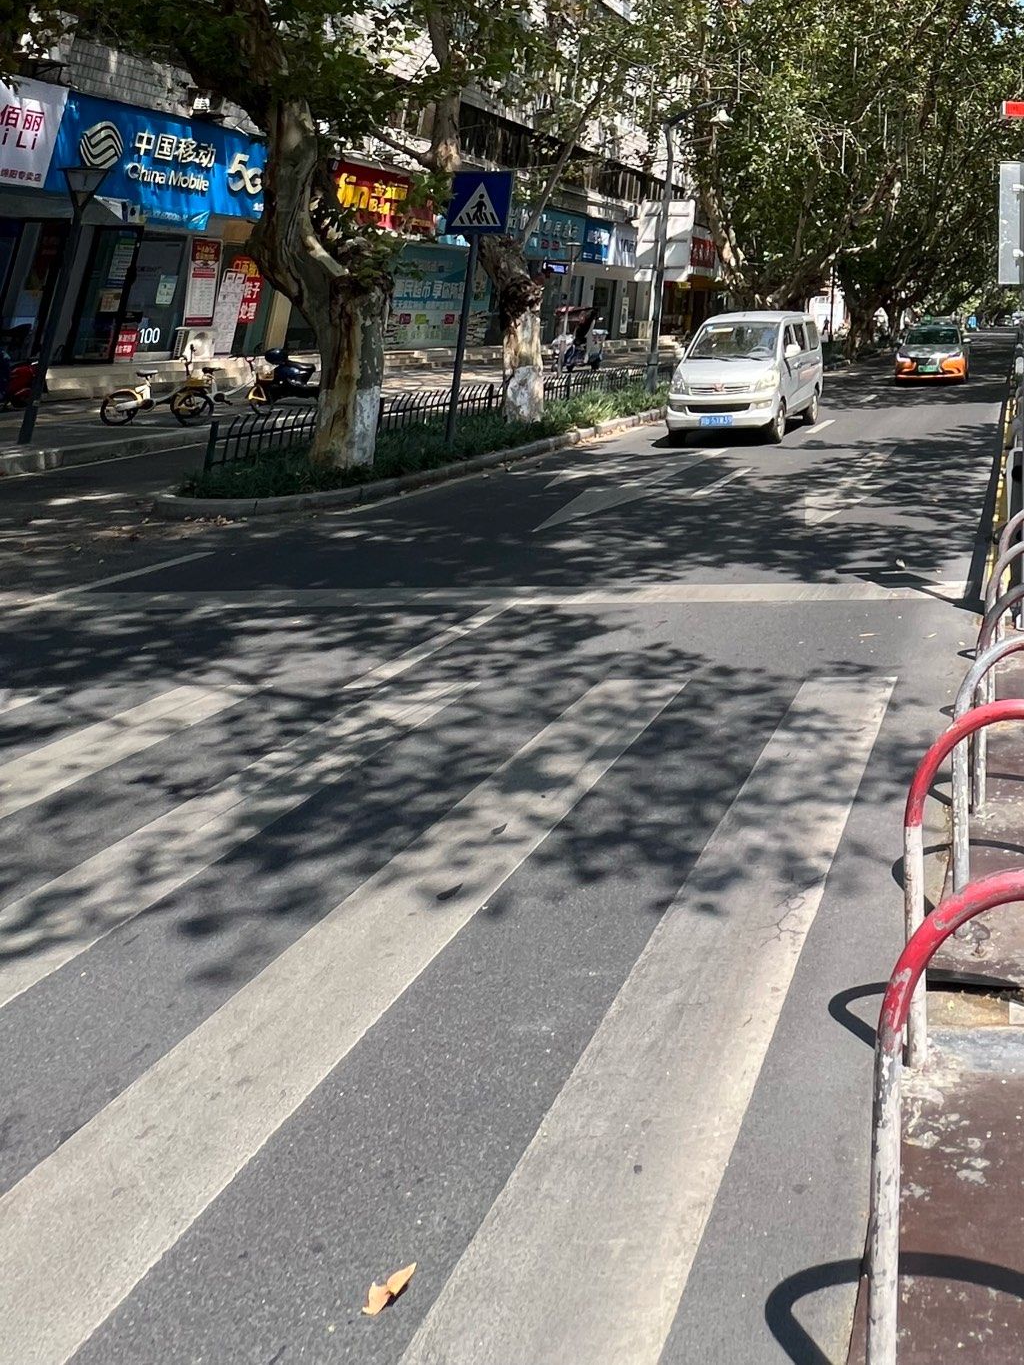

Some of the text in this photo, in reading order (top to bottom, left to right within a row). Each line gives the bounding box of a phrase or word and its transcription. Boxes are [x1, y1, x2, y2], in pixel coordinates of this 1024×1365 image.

[134, 128, 216, 168] 中国移动
[127, 161, 210, 192] China Mobile
[228, 153, 264, 195] 5G
[139, 327, 160, 345] 100
